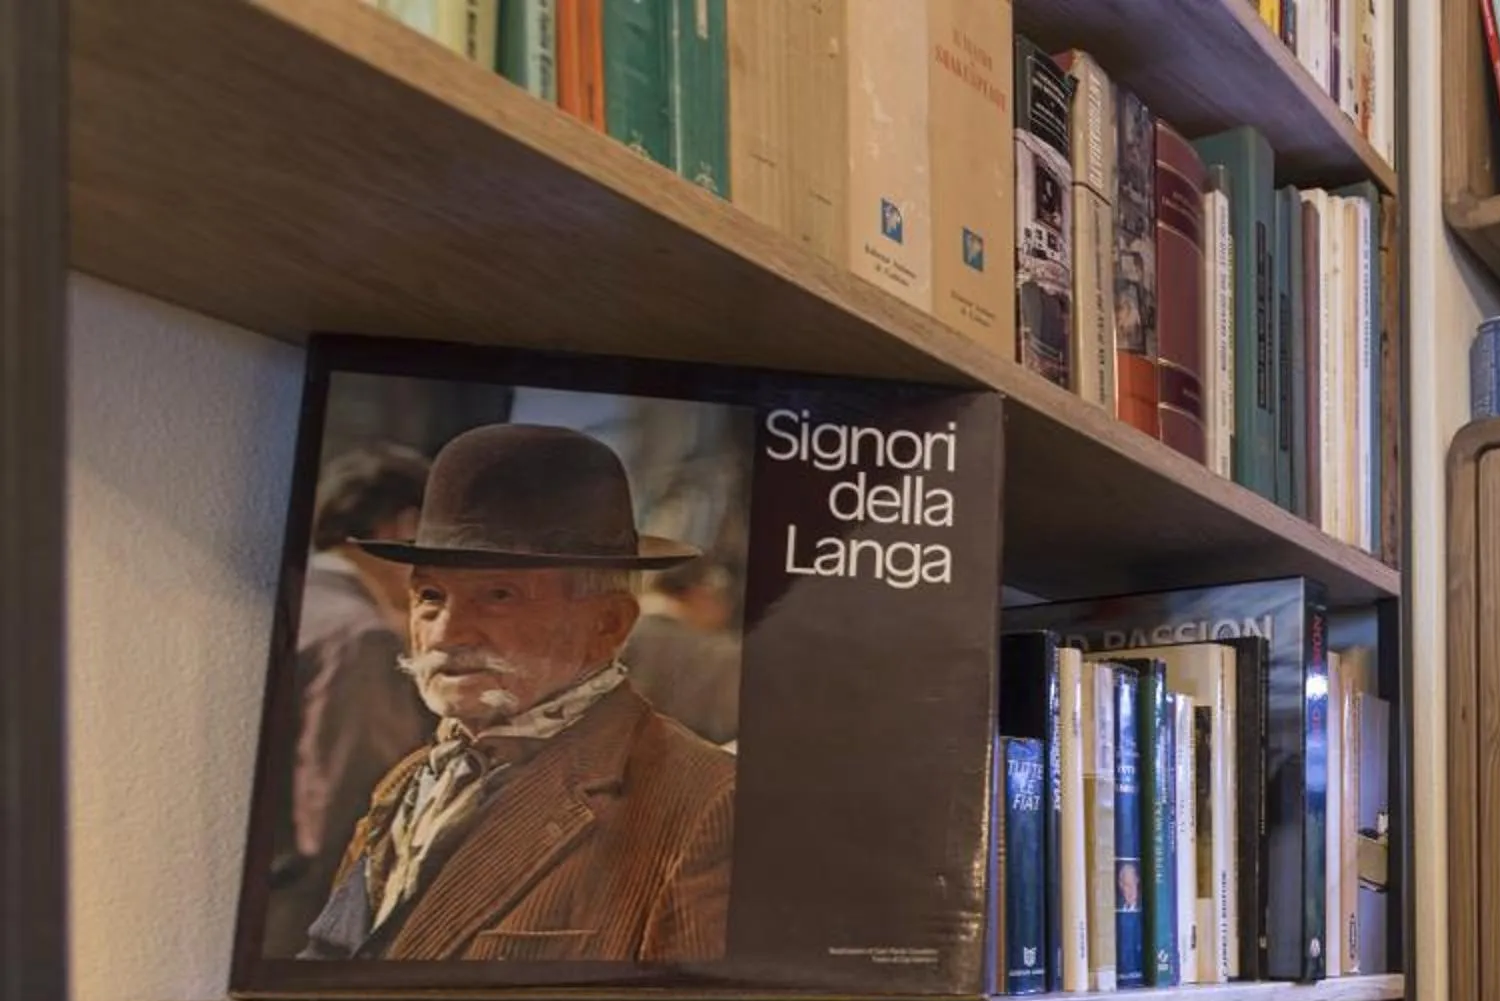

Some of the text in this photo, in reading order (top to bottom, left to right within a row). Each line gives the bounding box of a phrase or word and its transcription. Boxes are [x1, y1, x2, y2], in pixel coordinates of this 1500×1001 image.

[766, 410, 956, 472] Signori
[828, 473, 953, 526] della
[784, 524, 951, 588] Langa
[1104, 614, 1274, 649] PASSION
[1007, 758, 1043, 777] TUTTE
[1012, 793, 1040, 812] FIAT
[1020, 778, 1036, 795] LE
